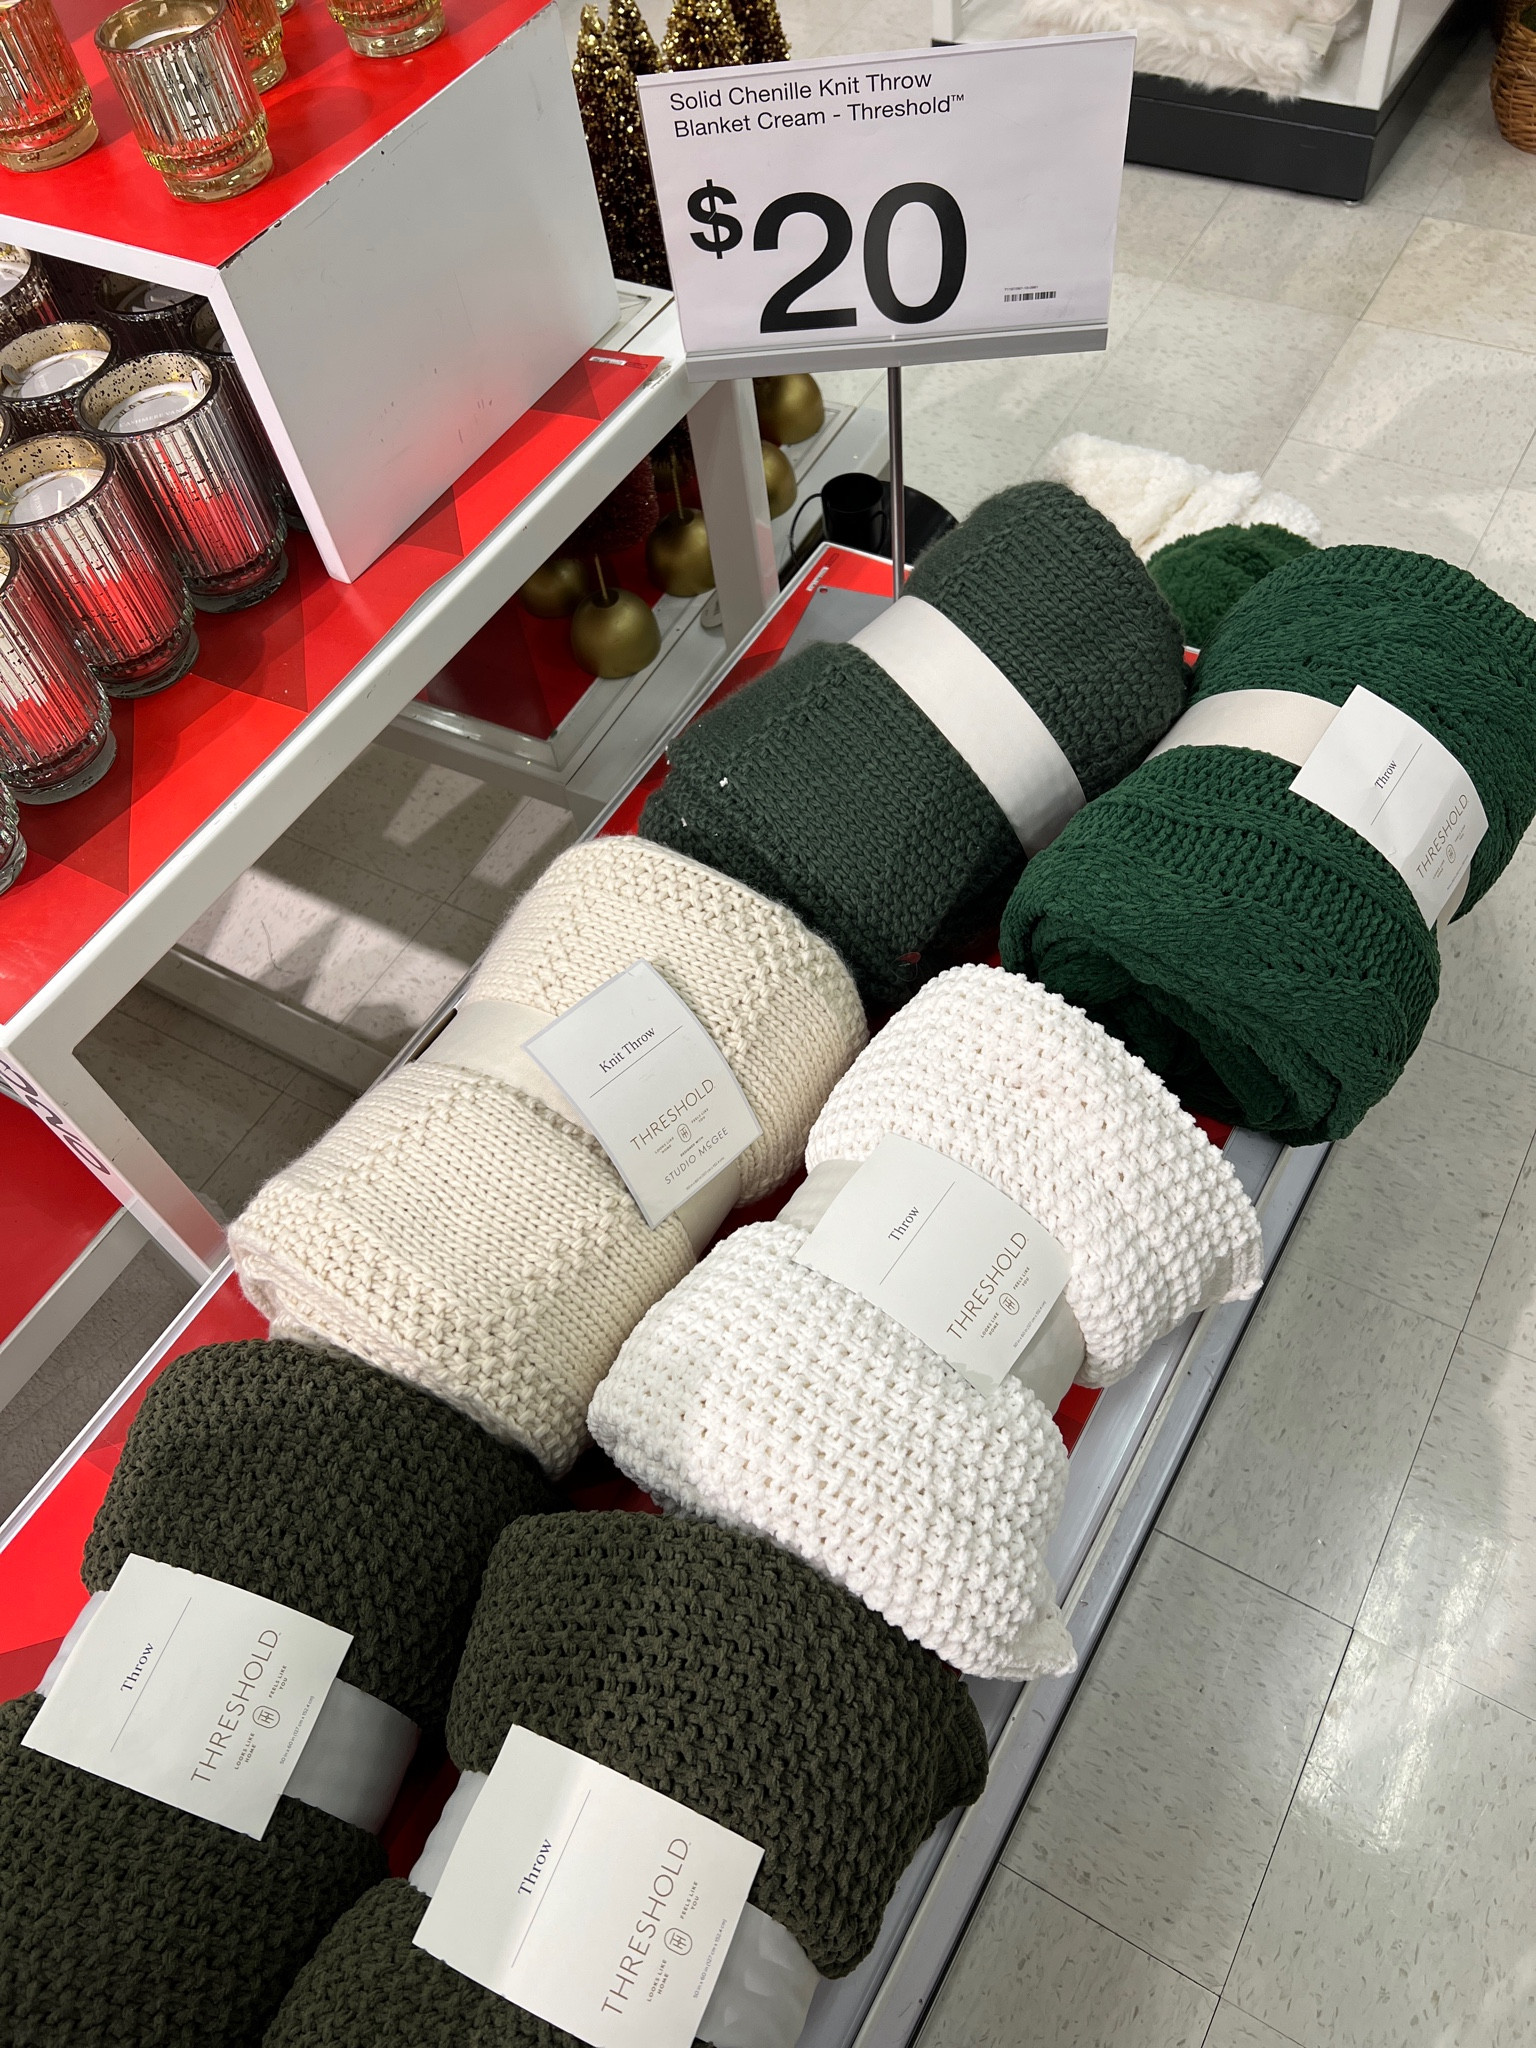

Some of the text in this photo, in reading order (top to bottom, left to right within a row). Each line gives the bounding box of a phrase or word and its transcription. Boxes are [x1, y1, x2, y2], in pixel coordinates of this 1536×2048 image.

[669, 72, 932, 112] Solid Chenille Knit Throw
[674, 114, 752, 139] Blanket
[757, 109, 826, 131] Cream
[686, 178, 968, 334] $20
[1374, 760, 1398, 790] Throw
[1416, 794, 1469, 879] THRESHOLD
[599, 1027, 656, 1074] Knit Throw
[629, 1078, 715, 1152] THRESHOLD
[664, 1154, 697, 1185] STUDIO
[888, 1205, 920, 1242] Throw
[946, 1232, 1028, 1340] THRESHOLD
[120, 1642, 155, 1693] Throw
[268, 1665, 288, 1699] FEELS LIKE
[278, 1677, 289, 1691] YOU
[190, 1629, 280, 1783] THRESHOLD
[234, 1732, 255, 1770] LOOKS LIKE
[244, 1744, 257, 1764] HOME
[517, 1838, 553, 1896] Throw
[679, 1881, 699, 1920] FEELS LIKE
[690, 1895, 700, 1911] YOU
[601, 1838, 689, 2015] THRESHOLD
[646, 1959, 668, 2003] LOOKS LIKE
[657, 1973, 670, 1995] HOME
